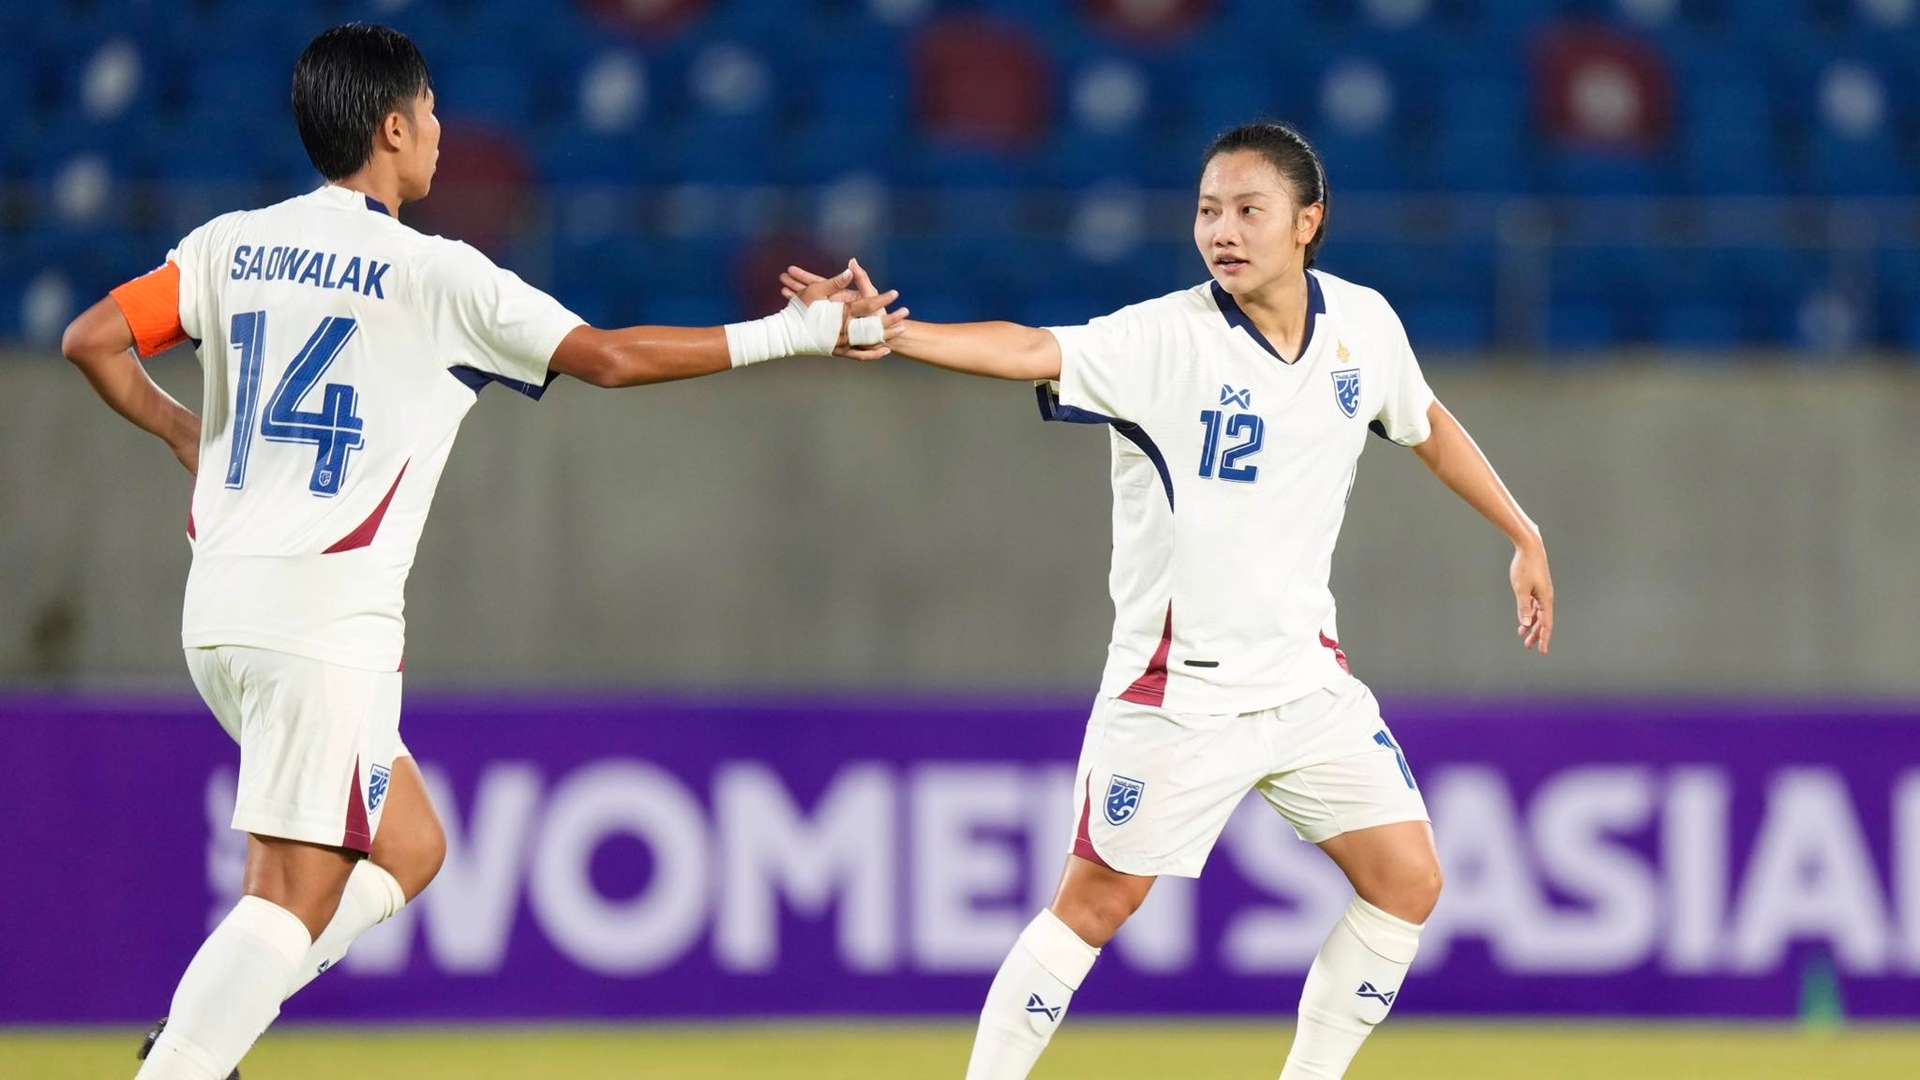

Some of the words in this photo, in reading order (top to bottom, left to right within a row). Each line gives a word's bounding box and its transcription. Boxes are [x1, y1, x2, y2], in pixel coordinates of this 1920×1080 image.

[231, 245, 391, 300] SAOWALAK
[224, 310, 365, 498] 14
[1199, 410, 1265, 484] 12
[343, 762, 1358, 975] WOMES
